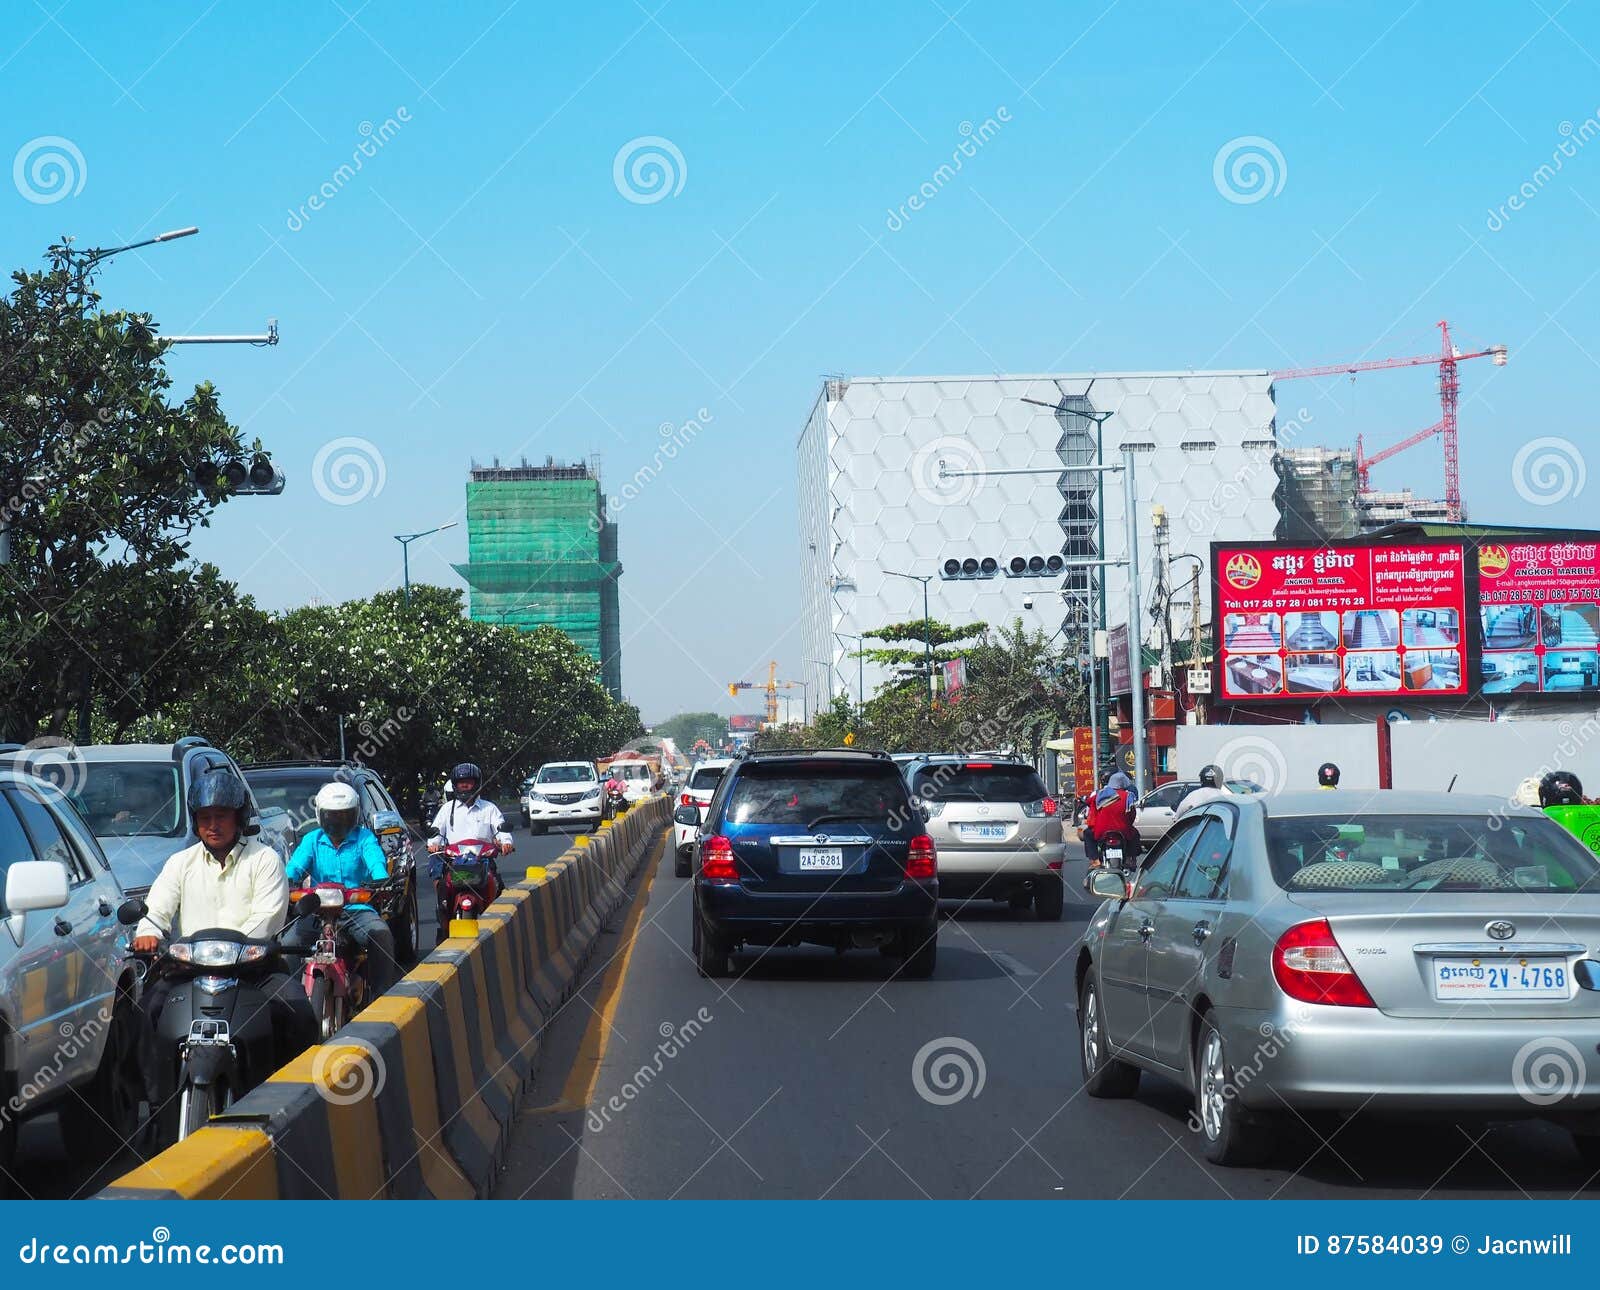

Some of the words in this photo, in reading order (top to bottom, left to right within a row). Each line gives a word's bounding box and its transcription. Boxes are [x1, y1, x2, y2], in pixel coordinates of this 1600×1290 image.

[1514, 567, 1553, 577] ANGKOR
[1557, 566, 1595, 575] MARBLE
[1285, 578, 1313, 586] ANGKOR
[1480, 592, 1491, 602] el:
[1493, 590, 1508, 601] 017
[1510, 590, 1520, 601] 28
[1522, 590, 1532, 600] 57
[1534, 589, 1545, 600] 28
[1551, 589, 1566, 599] 081
[1568, 588, 1579, 599] 75
[1581, 588, 1592, 598] 76
[1243, 599, 1260, 608] 017
[1262, 598, 1274, 607] 28
[1275, 598, 1287, 607] 57
[1289, 598, 1301, 607] 28
[1307, 598, 1324, 606] 081
[1326, 597, 1338, 606] 75
[1340, 597, 1352, 606] 76
[1353, 597, 1365, 605] 28
[801, 856, 841, 866] 2AJ-6281
